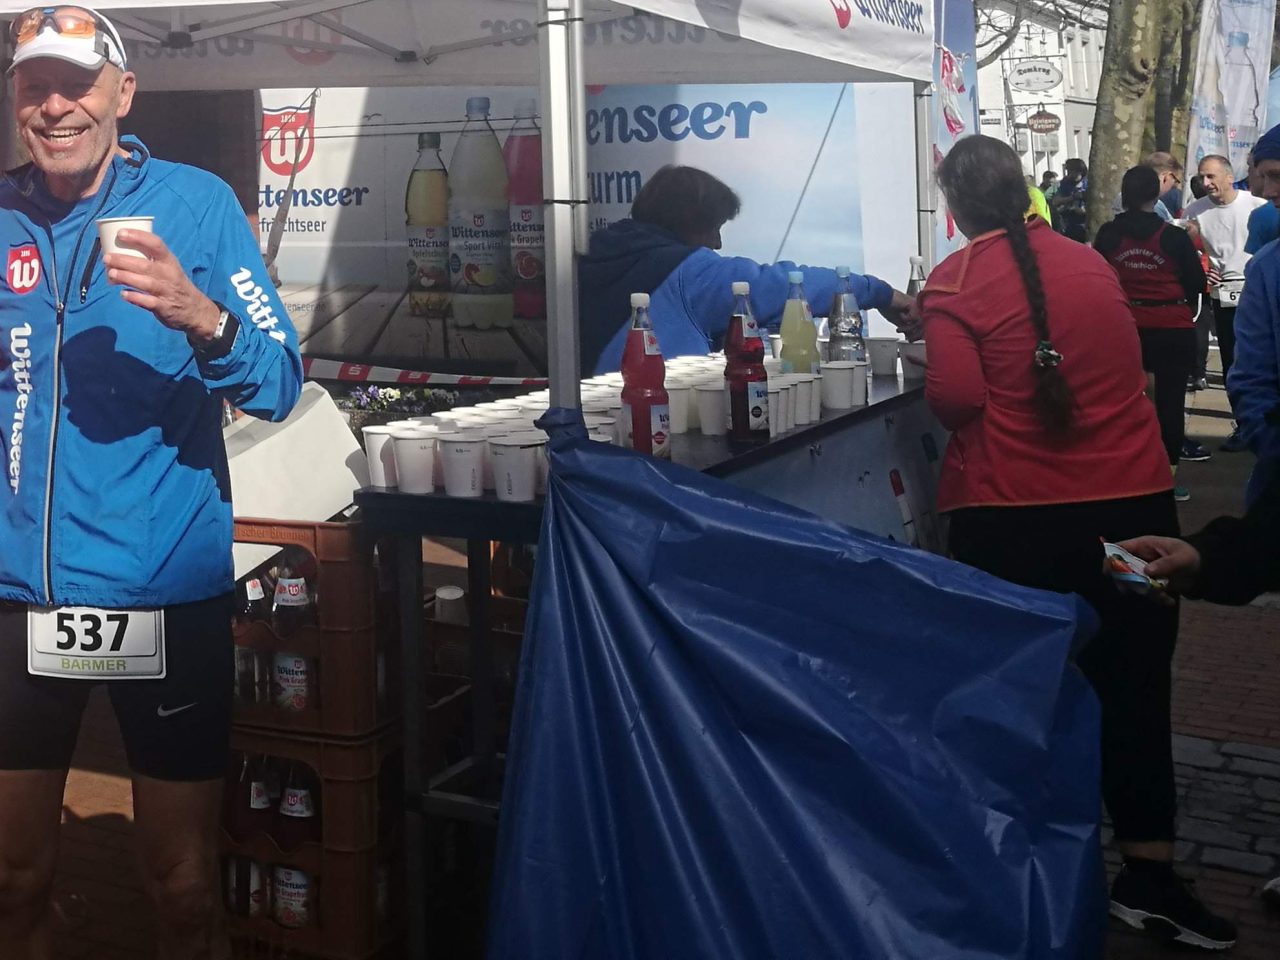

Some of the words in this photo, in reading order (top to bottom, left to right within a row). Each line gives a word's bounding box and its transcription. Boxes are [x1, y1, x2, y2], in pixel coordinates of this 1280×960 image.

[9, 321, 34, 496] Wittenseer
[55, 613, 130, 653] 537
[60, 657, 128, 672] BARMER
